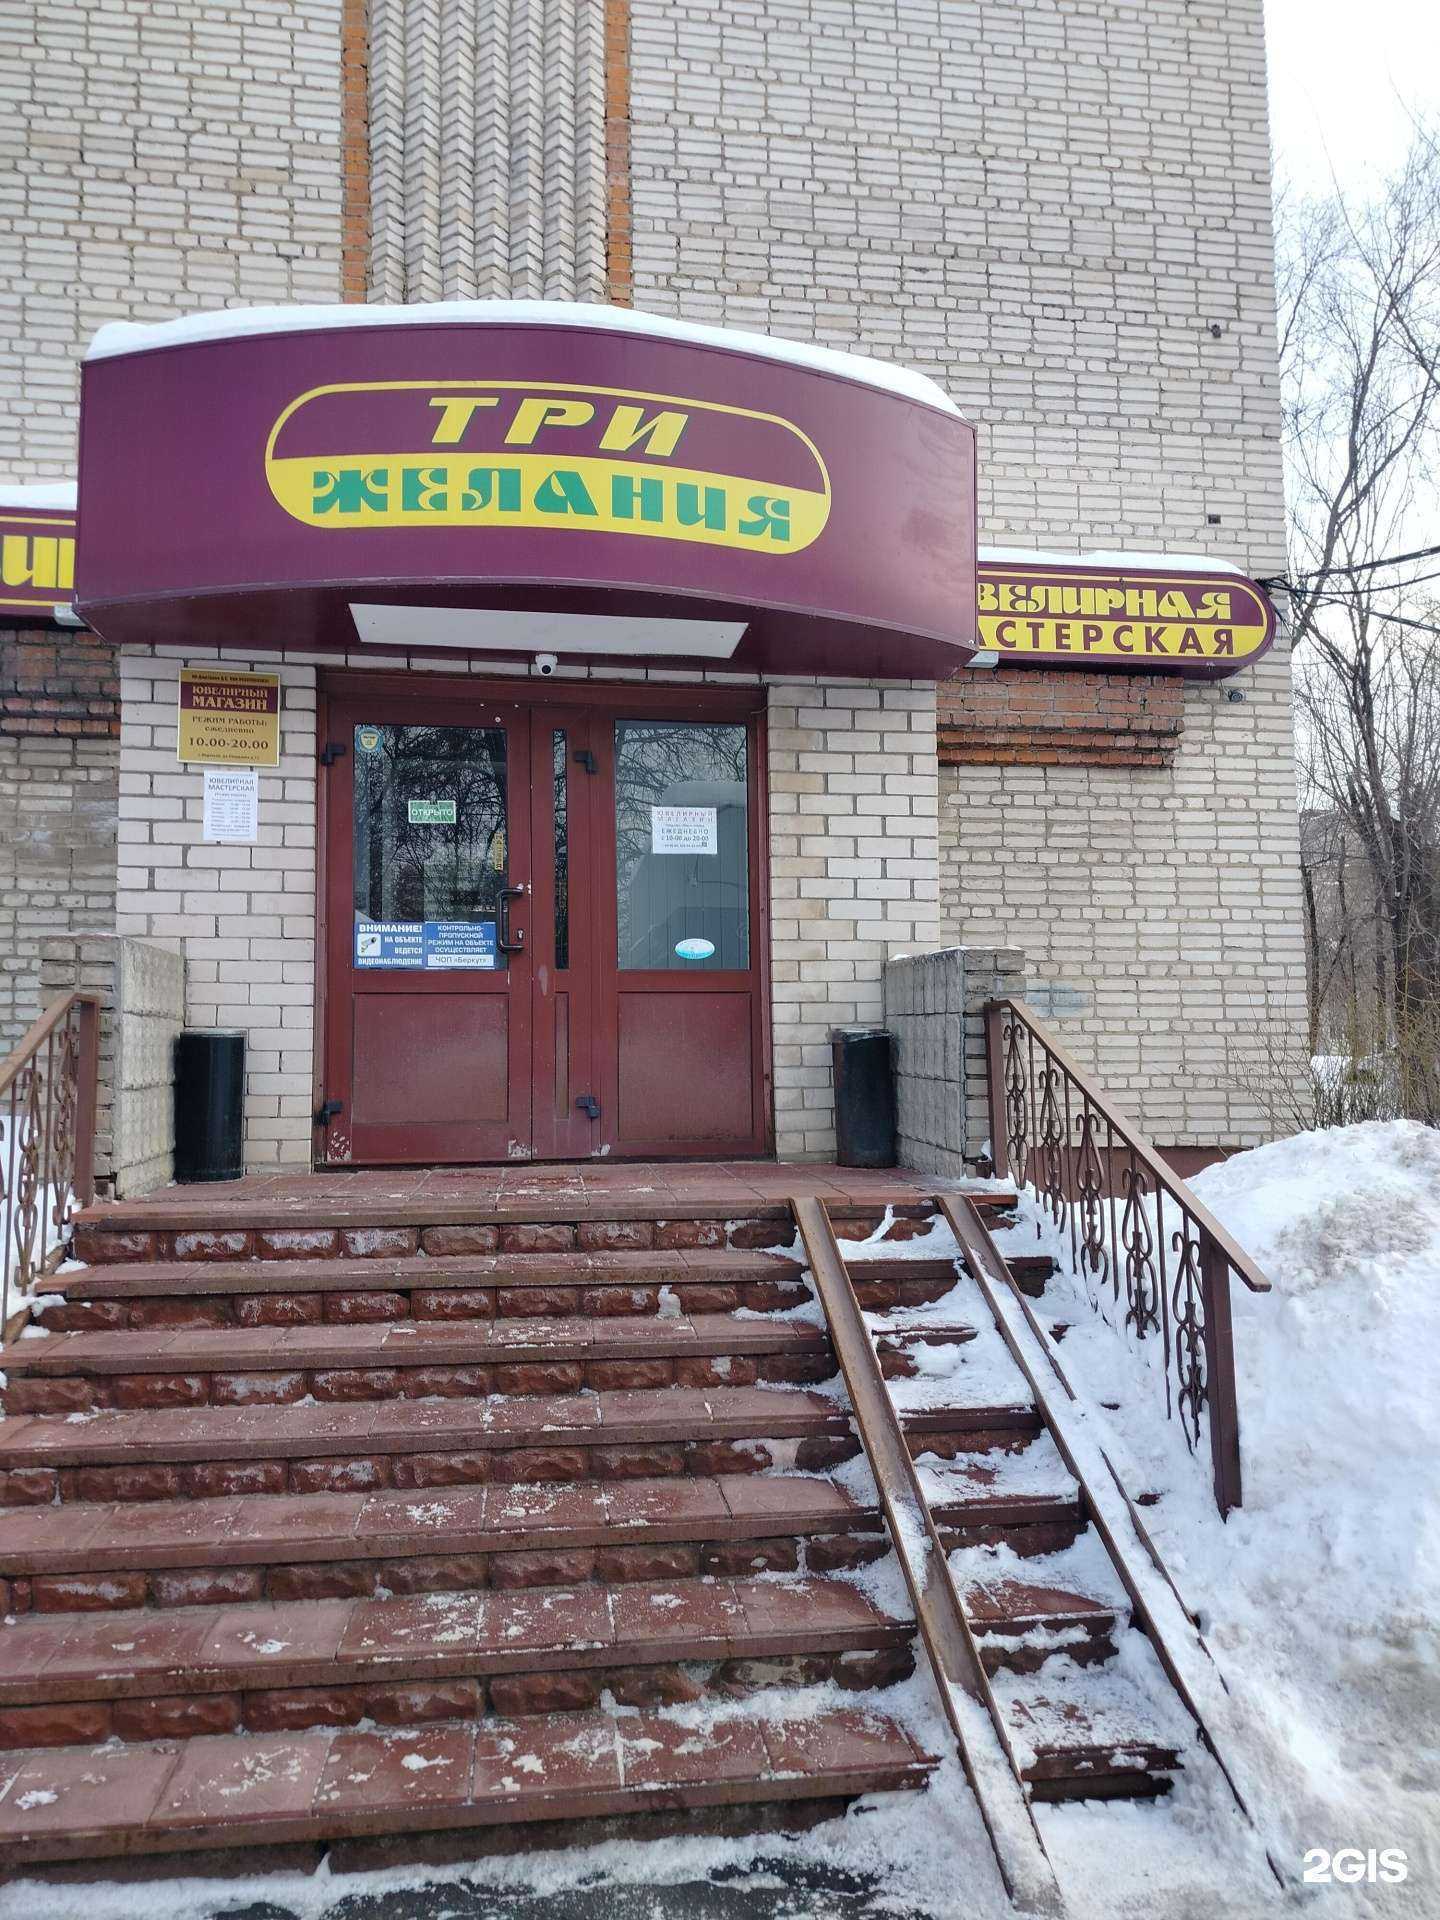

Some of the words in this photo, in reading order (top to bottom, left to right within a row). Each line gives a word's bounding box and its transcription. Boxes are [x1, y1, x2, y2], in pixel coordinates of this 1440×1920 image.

[429, 397, 689, 456] ТРИ
[313, 467, 790, 542] ЖЕЛАНИЯ
[192, 685, 268, 698] ЮВЕЛИРНЫЙ
[192, 695, 268, 710] МАГАЗИН
[189, 737, 269, 750] 10.00-20.00
[411, 808, 453, 816] ОТКРЫТО
[359, 924, 423, 933] ВНИМАНИЕ!
[384, 935, 394, 943] НА
[394, 936, 423, 944] ОБЪЕКТЕ
[357, 957, 423, 966] ВИДЕОНАБЛЮДЕНИЕ
[435, 955, 452, 963] ЧОП
